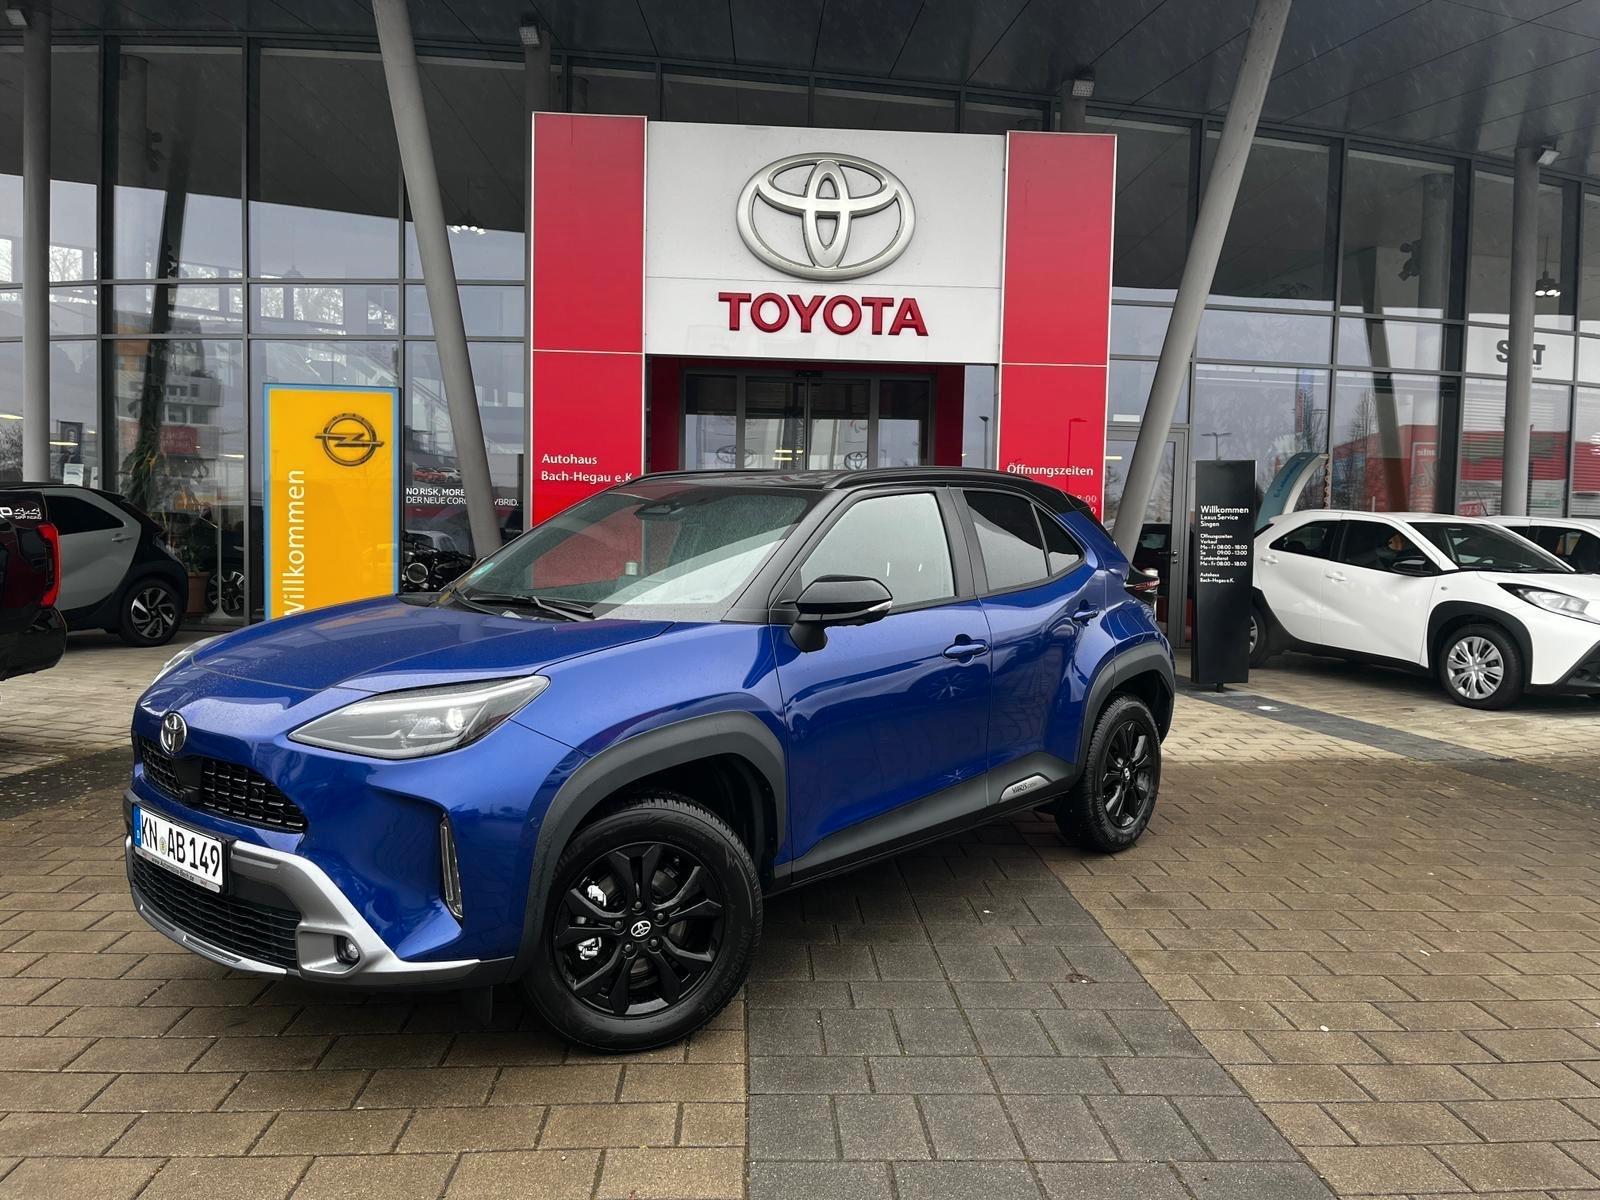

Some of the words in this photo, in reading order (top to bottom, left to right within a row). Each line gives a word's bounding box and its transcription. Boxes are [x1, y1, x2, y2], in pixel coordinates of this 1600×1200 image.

[718, 291, 929, 337] TOYOTA
[1496, 340, 1546, 366] ST
[541, 453, 598, 465] Autohaus
[1006, 462, 1094, 478] Öffnungszeiten
[541, 470, 611, 485] Bach-Hegau
[405, 487, 419, 496] NO
[420, 487, 441, 497] RISK,
[442, 488, 465, 497] MORE
[405, 496, 423, 504] DER
[424, 496, 446, 505] NEUE
[1200, 505, 1249, 514] Willkommen
[1200, 520, 1220, 528] Singen
[141, 814, 158, 851] KN
